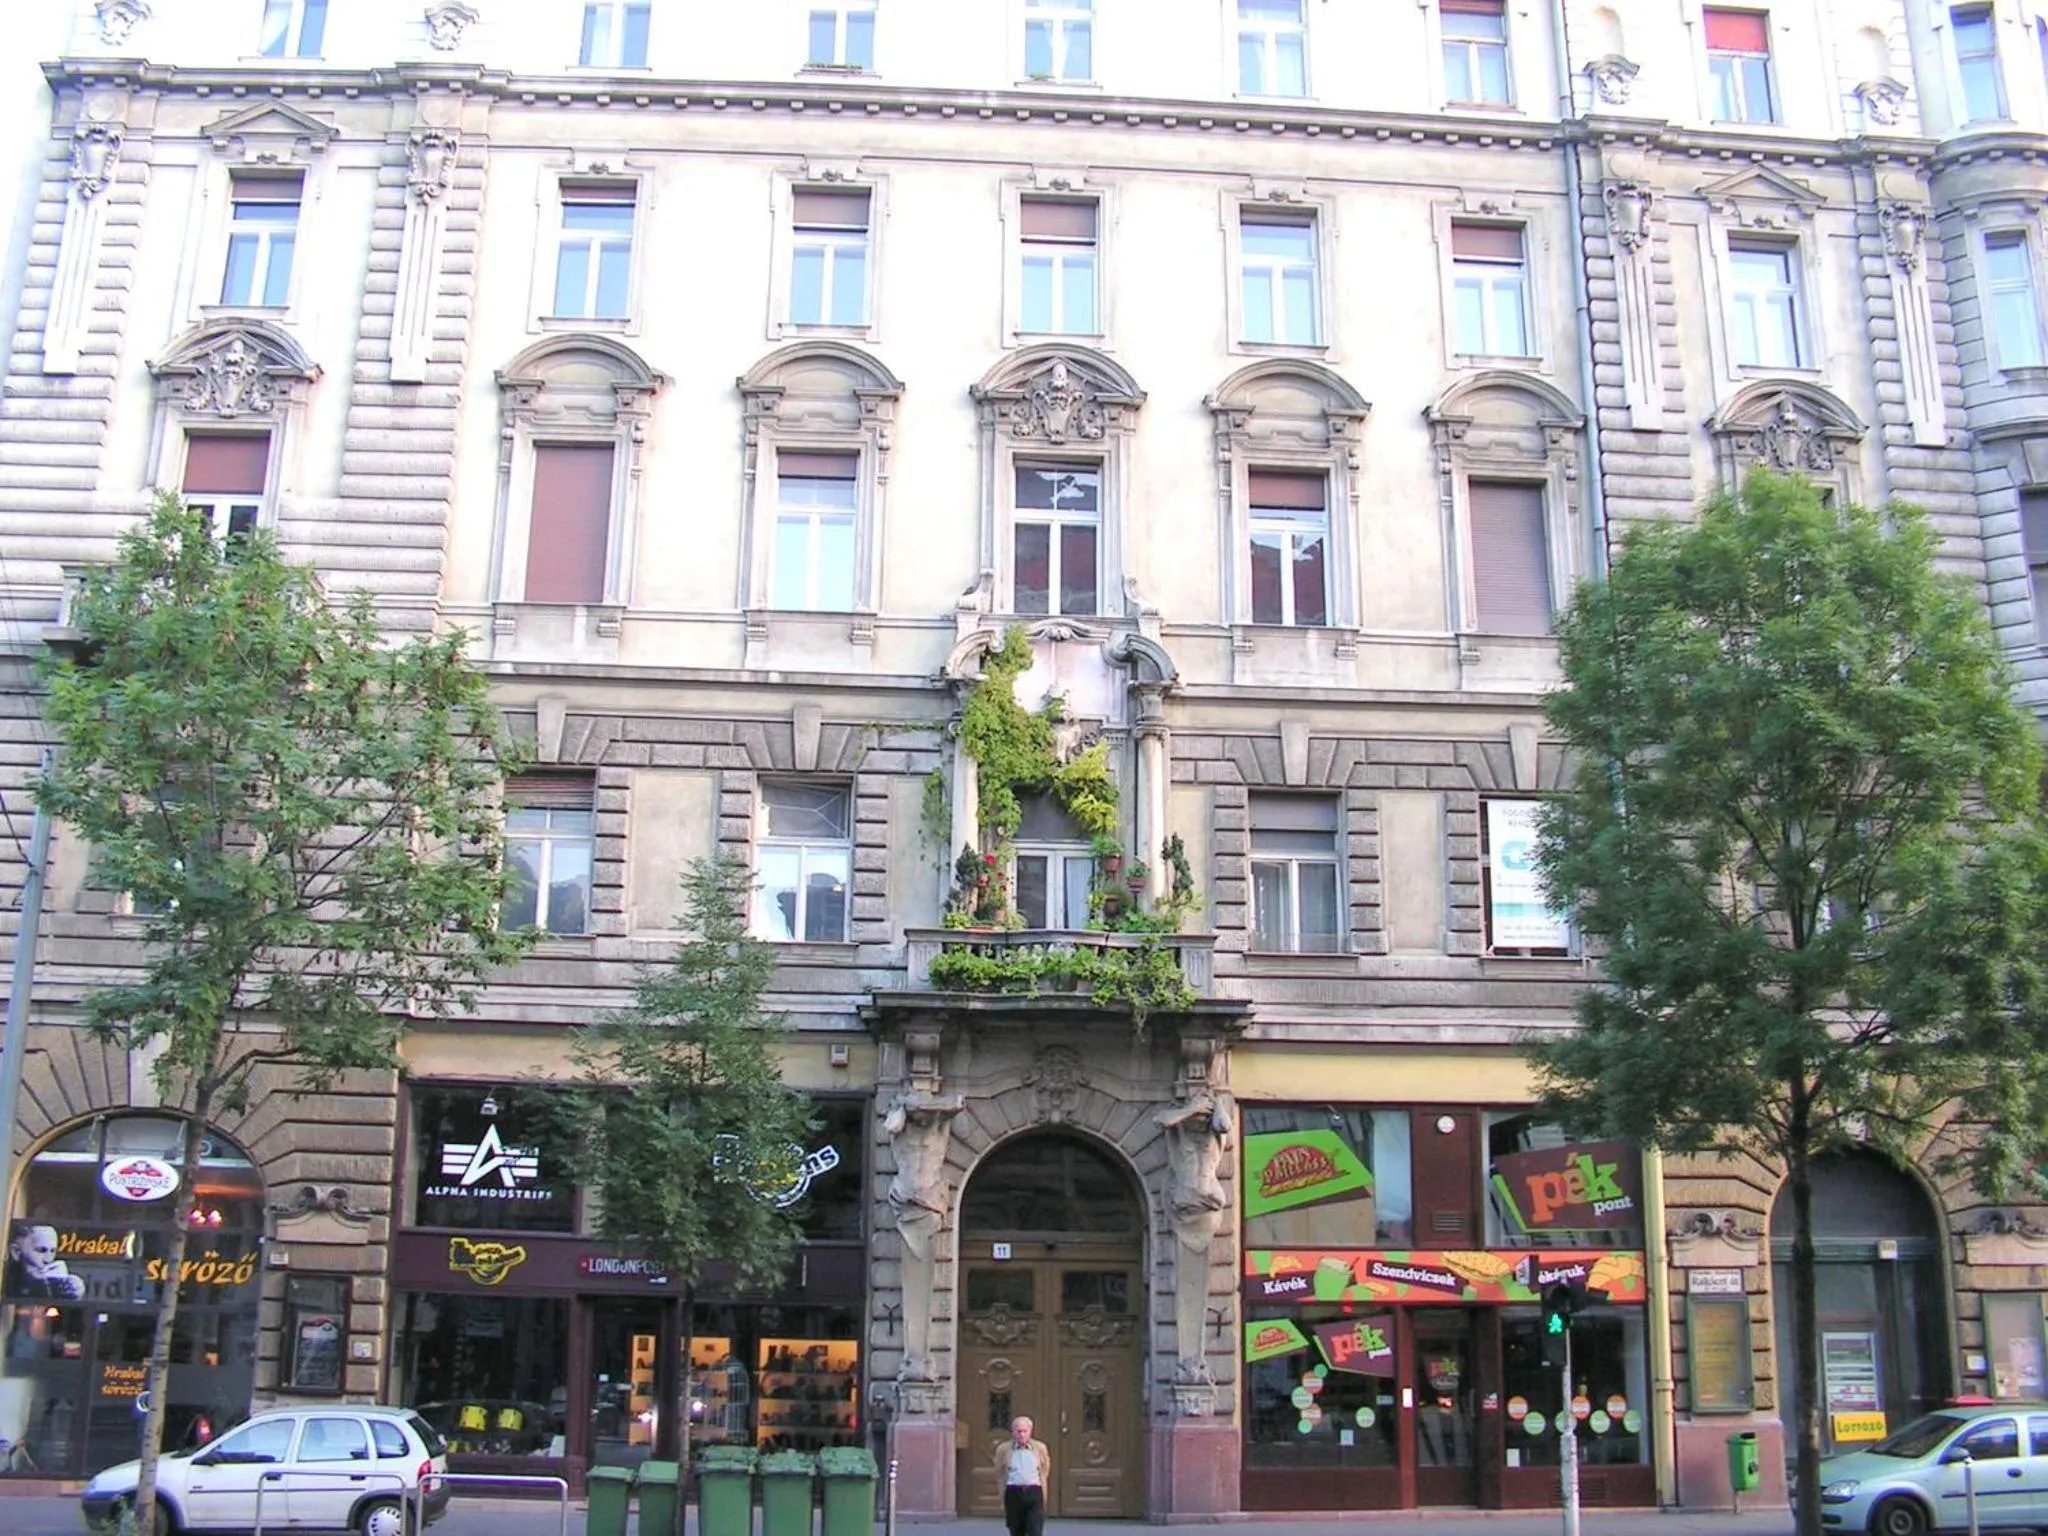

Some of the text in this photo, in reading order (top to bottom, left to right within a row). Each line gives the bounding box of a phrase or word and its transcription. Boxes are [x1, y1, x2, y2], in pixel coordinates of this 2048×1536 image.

[426, 1186, 468, 1197] ALPHA
[1526, 1152, 1623, 1223] pék
[1593, 1196, 1634, 1216] pont
[59, 1232, 131, 1255] Hrabal
[1264, 1277, 1308, 1294] Kávék
[1372, 1262, 1456, 1286] Szendvicsek
[1332, 1323, 1387, 1362] pék
